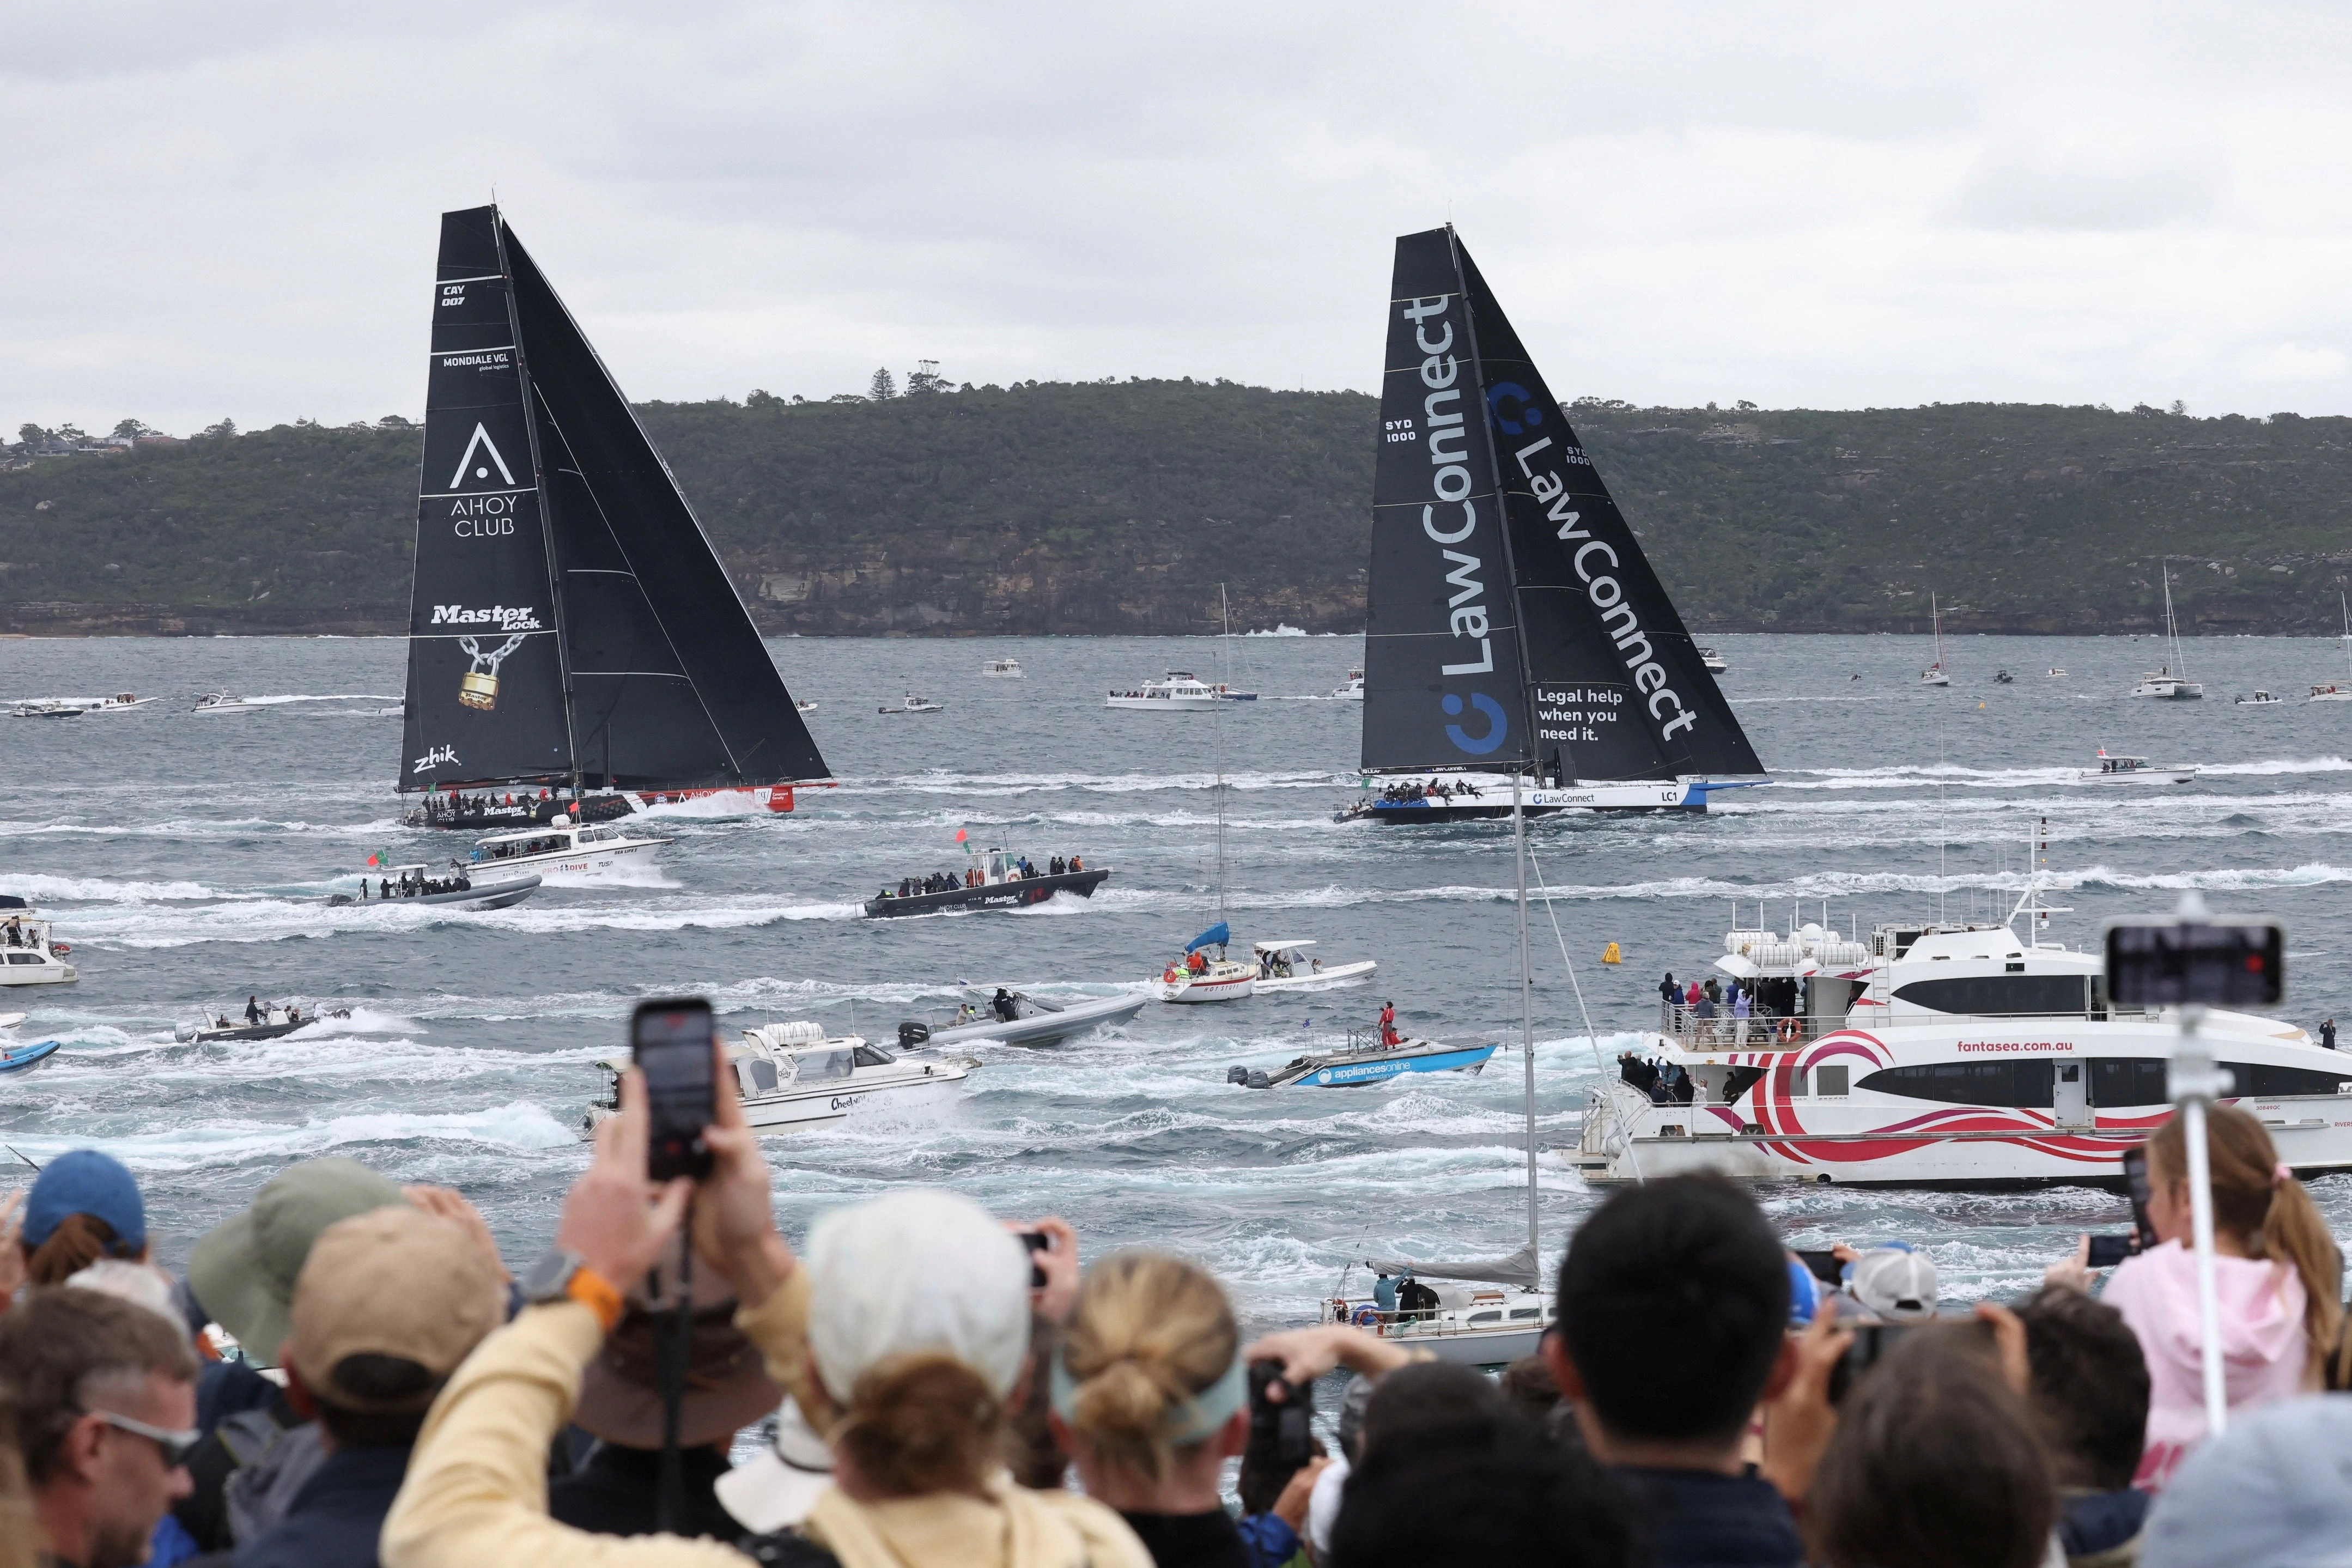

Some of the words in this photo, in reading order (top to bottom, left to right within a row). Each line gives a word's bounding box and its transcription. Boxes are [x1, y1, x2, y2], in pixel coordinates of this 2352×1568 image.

[443, 285, 465, 295] CAY
[442, 297, 465, 306] 007
[443, 355, 492, 367] MONDIALE
[493, 354, 508, 362] VGL
[1385, 419, 1412, 430] SYD
[1387, 431, 1416, 442] 1000
[1566, 455, 1590, 466] 1000
[1404, 293, 1494, 676] LawConnect
[451, 495, 517, 516] AHOY
[455, 518, 514, 537] CLUB
[1515, 436, 1697, 742] LawConnect
[431, 605, 533, 624] Master
[465, 692, 487, 701] Master
[1537, 688, 1582, 705] Legal
[1588, 689, 1622, 706] help
[1539, 708, 1582, 721] when
[1587, 712, 1616, 724] you
[1540, 727, 1577, 740] need
[1582, 727, 1599, 741] it.
[690, 790, 714, 799] AHOY
[1544, 794, 1595, 804] LawConnect
[1662, 792, 1677, 801] LC1
[483, 806, 523, 816] Master
[984, 895, 1016, 904] Master
[1958, 1041, 2073, 1052] fantasea.com.au
[1366, 1073, 1391, 1081] legendary
